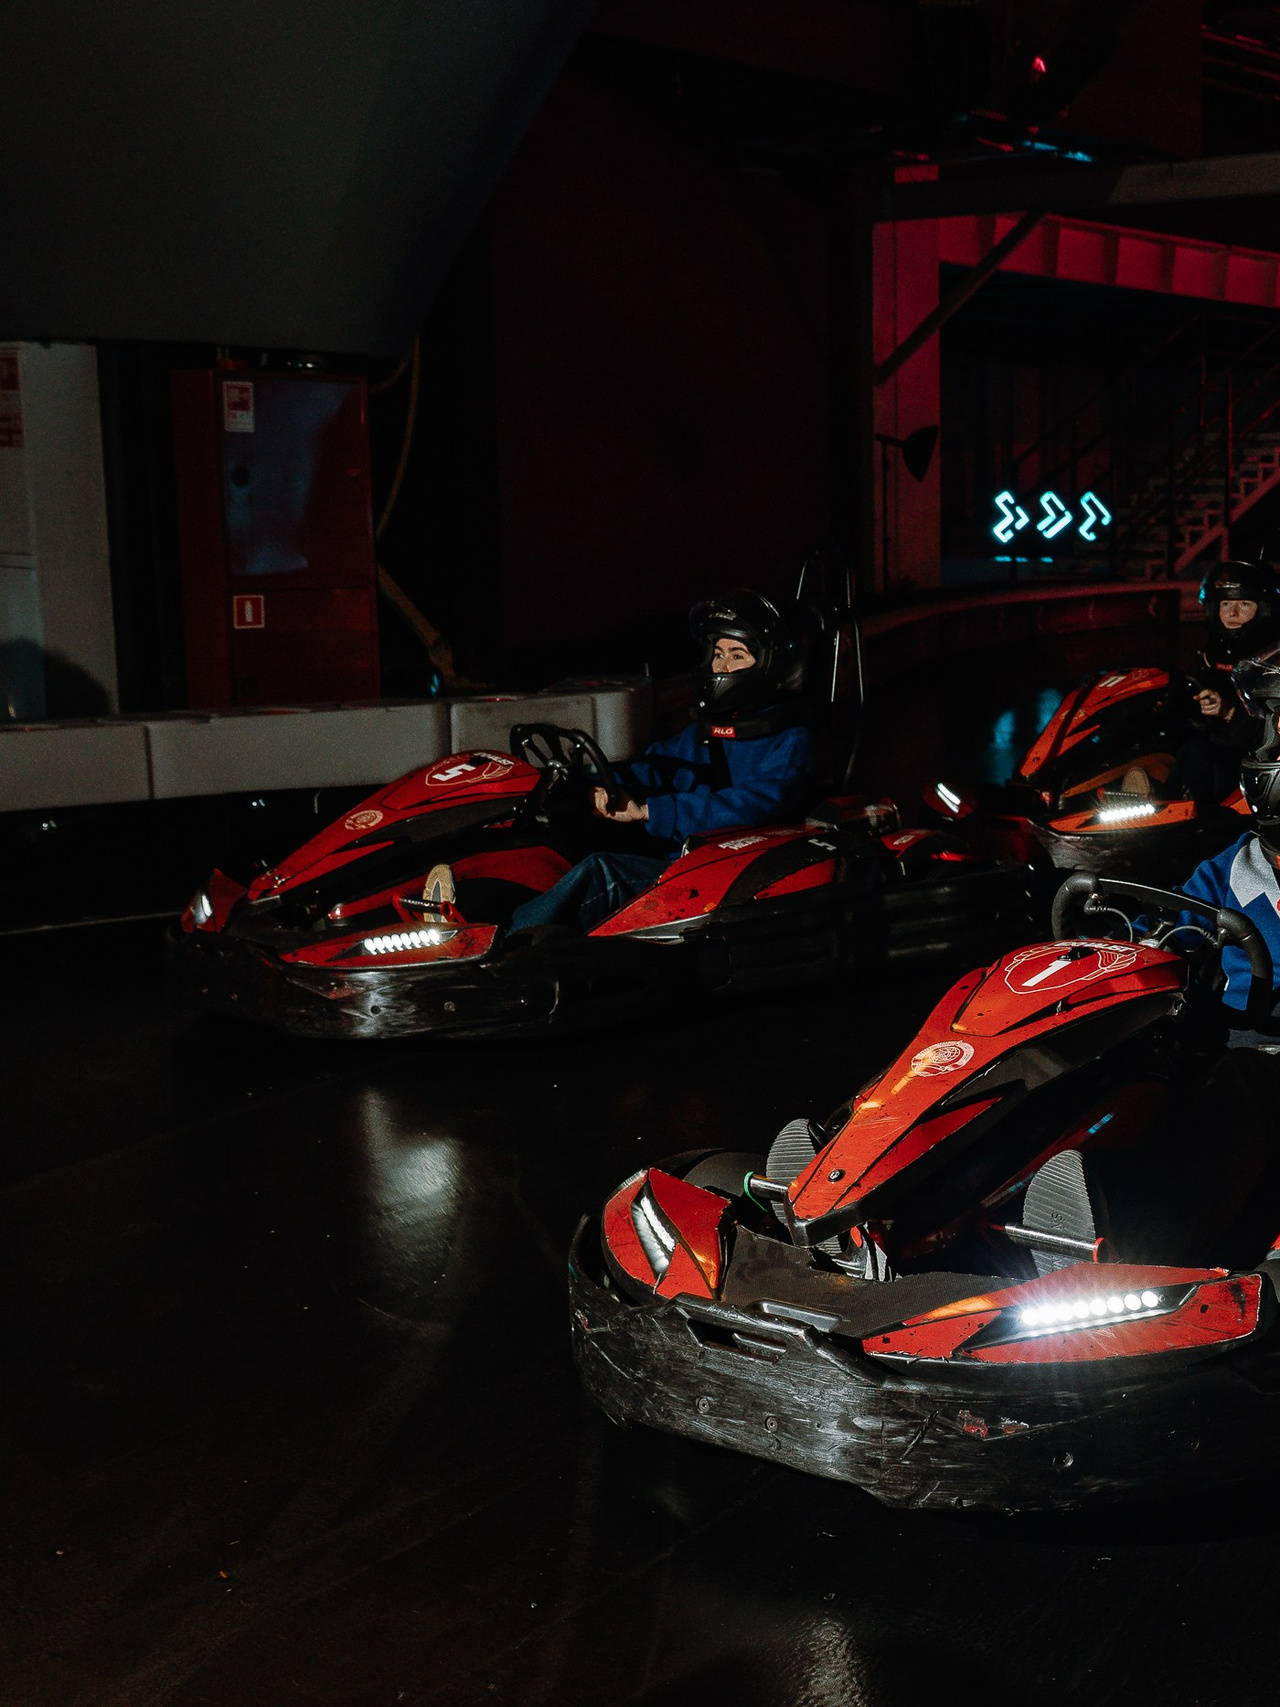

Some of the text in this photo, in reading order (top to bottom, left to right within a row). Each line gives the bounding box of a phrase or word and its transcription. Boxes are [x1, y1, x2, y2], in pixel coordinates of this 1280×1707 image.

[714, 727, 734, 735] RLG
[432, 764, 476, 782] 5
[1021, 959, 1072, 987] 1
